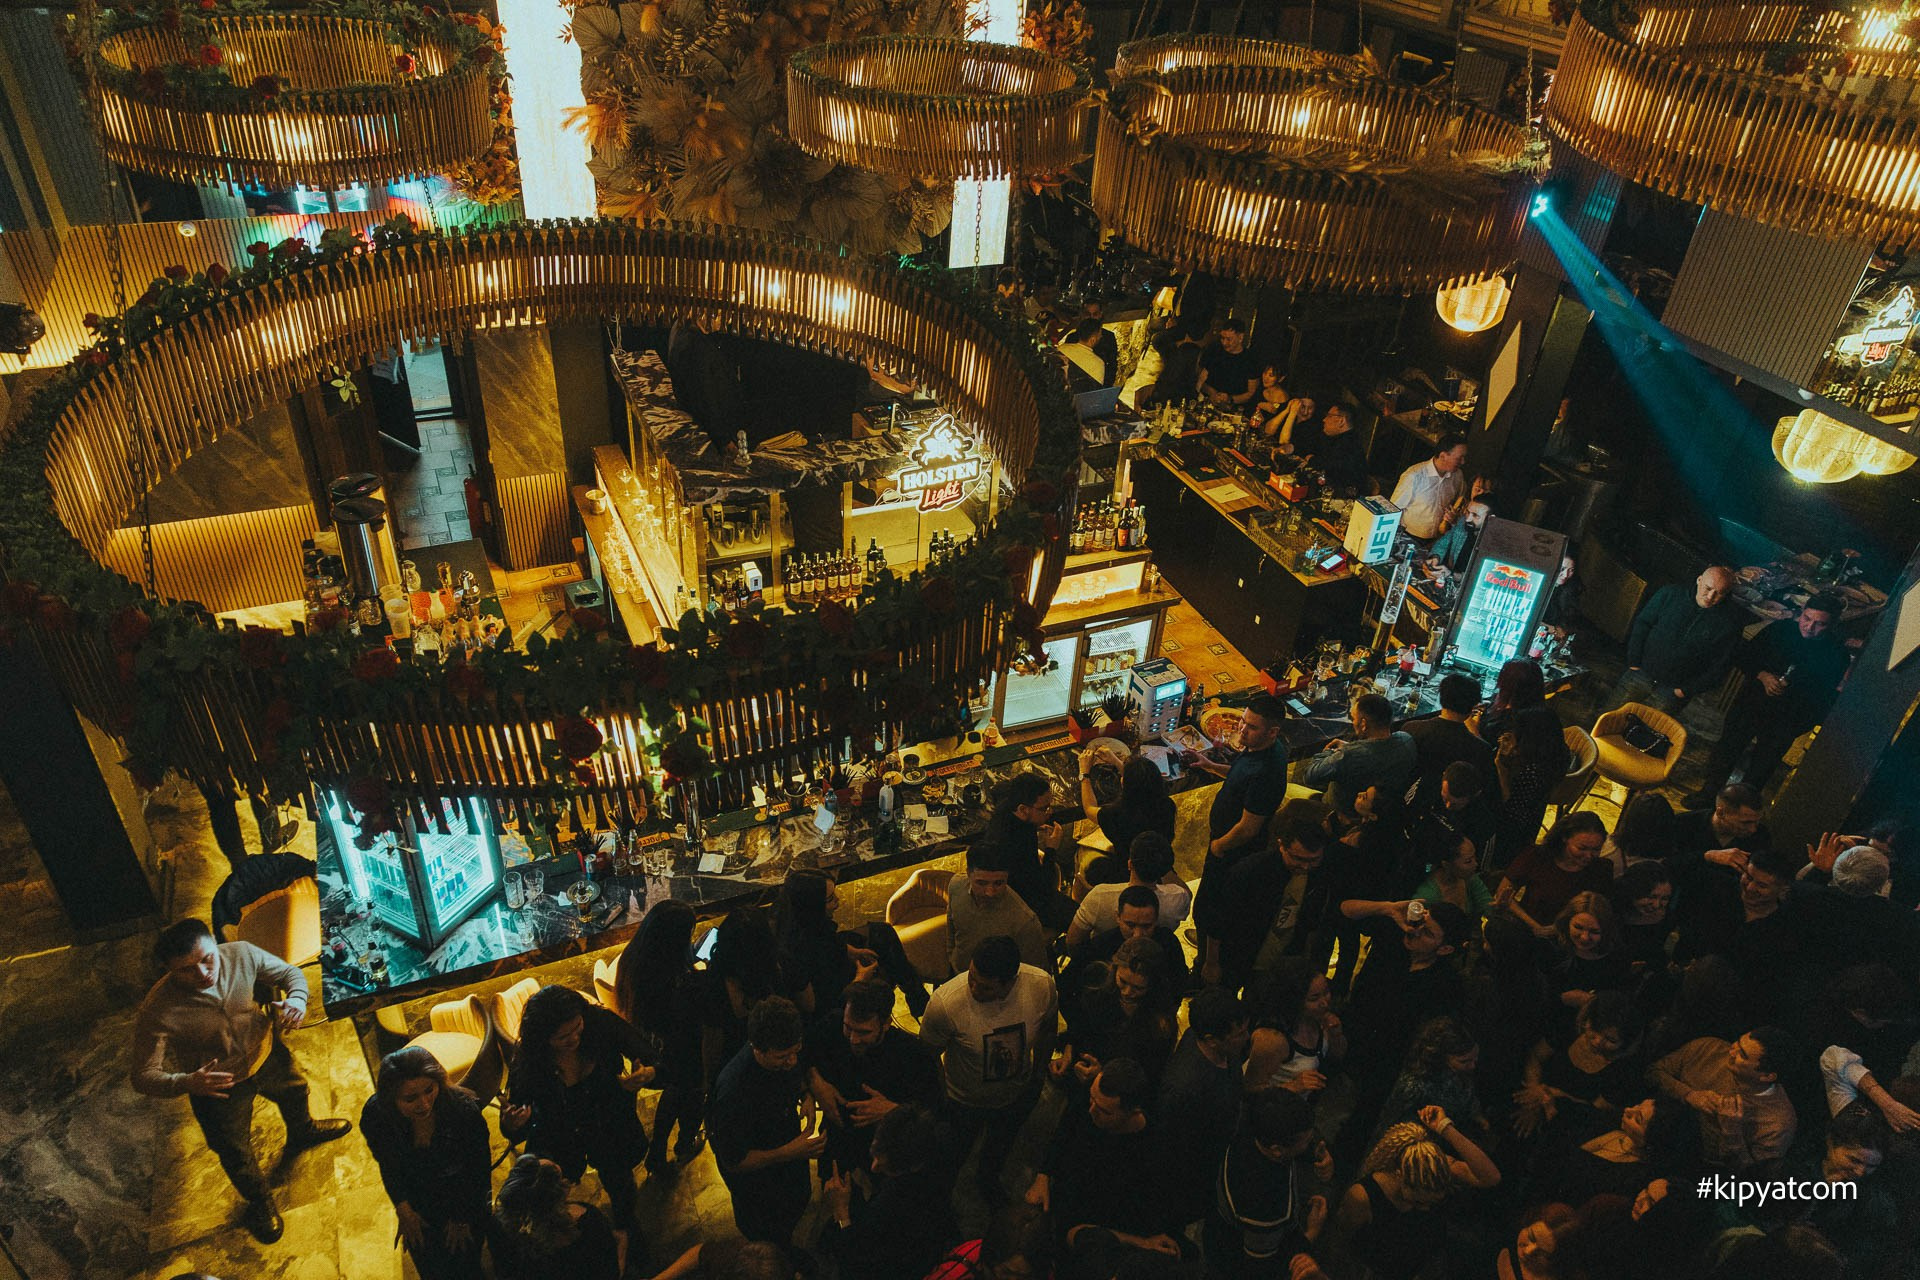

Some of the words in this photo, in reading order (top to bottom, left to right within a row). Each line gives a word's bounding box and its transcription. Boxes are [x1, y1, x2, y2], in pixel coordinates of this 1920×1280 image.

[903, 460, 977, 491] HOLSTEN
[922, 481, 960, 507] Light
[1370, 516, 1395, 559] JET
[1484, 571, 1508, 587] Red
[1509, 578, 1532, 593] Bull
